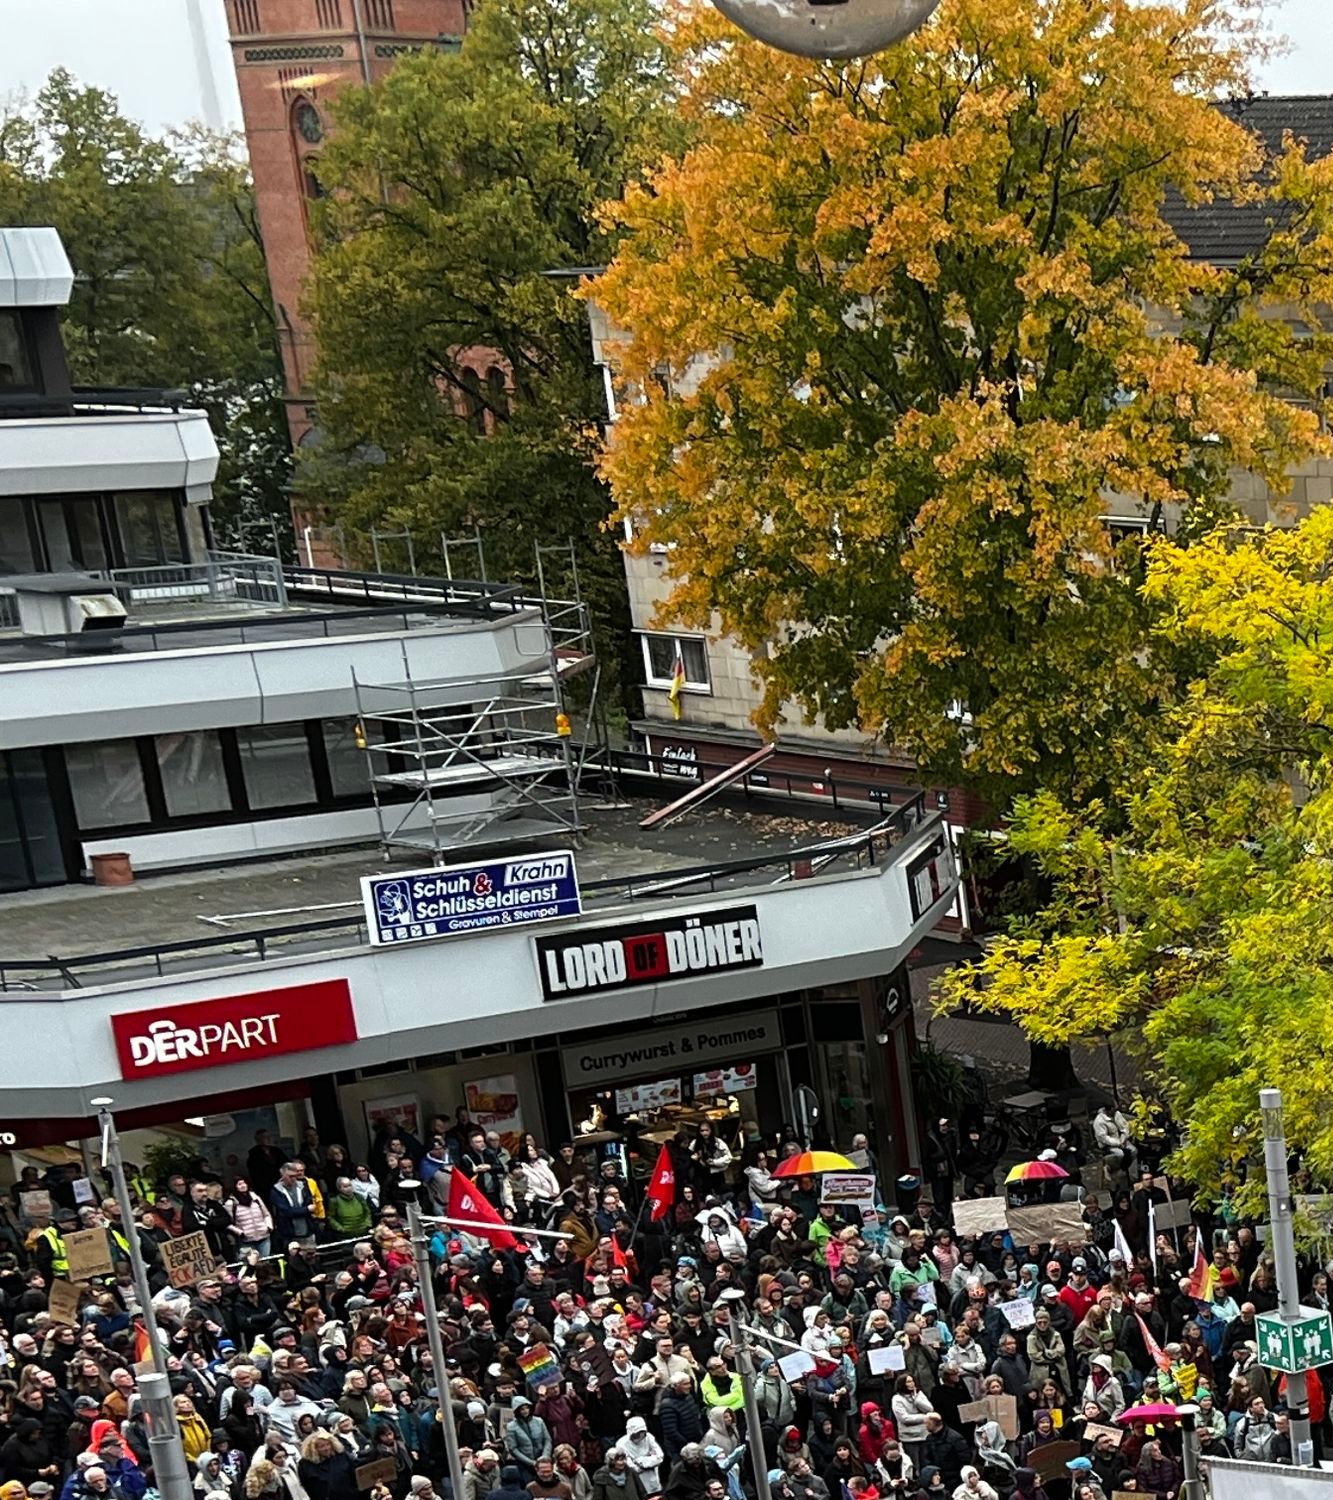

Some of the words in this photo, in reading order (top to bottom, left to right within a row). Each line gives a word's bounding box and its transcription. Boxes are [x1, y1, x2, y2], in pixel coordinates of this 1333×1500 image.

[413, 876, 470, 899] Schuh
[473, 872, 493, 896] &
[511, 861, 565, 883] Krahn
[416, 883, 558, 919] Schlüsseldienst
[448, 914, 500, 930] Gravuren
[501, 911, 513, 924] &
[513, 905, 559, 921] Stempel
[545, 940, 627, 992] LORD
[633, 942, 658, 971] OF
[664, 918, 763, 974] DÖNER
[580, 1041, 676, 1072] Currywurst
[681, 1037, 693, 1053] &
[697, 1025, 766, 1050] Pommes
[170, 1264, 194, 1285] FCK
[193, 1257, 215, 1277] AFD
